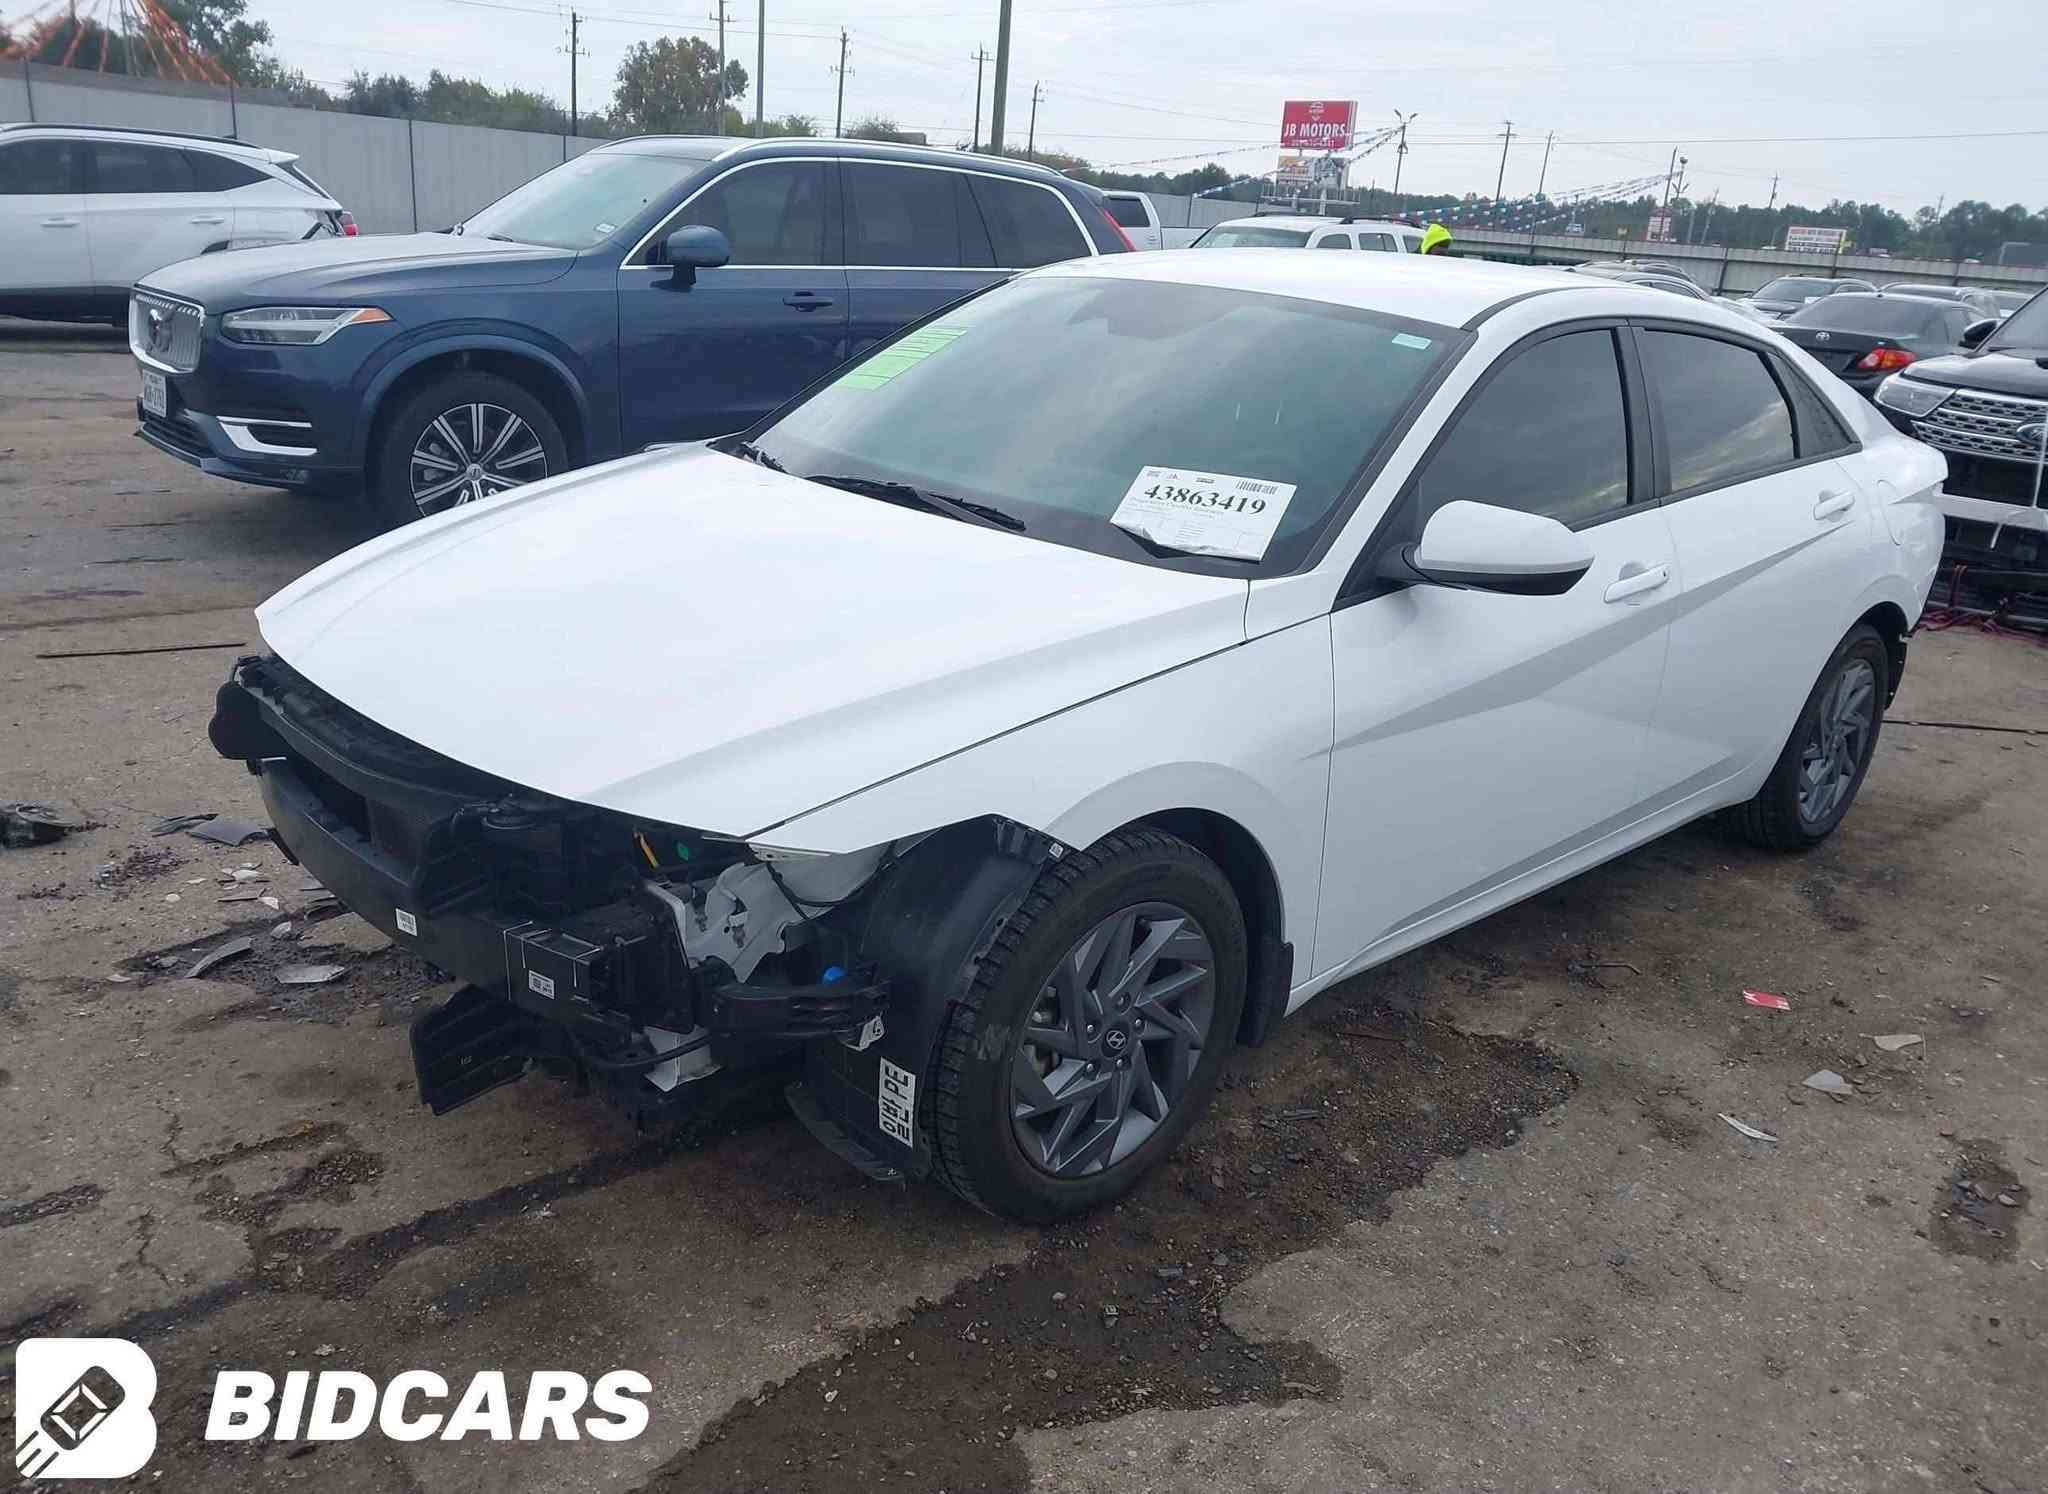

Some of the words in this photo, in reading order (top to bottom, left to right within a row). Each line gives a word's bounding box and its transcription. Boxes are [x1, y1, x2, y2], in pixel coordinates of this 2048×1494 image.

[1284, 123, 1297, 137] JB
[1300, 123, 1346, 137] MOTORS
[1144, 484, 1267, 515] 43863419
[884, 1065, 909, 1100] PE
